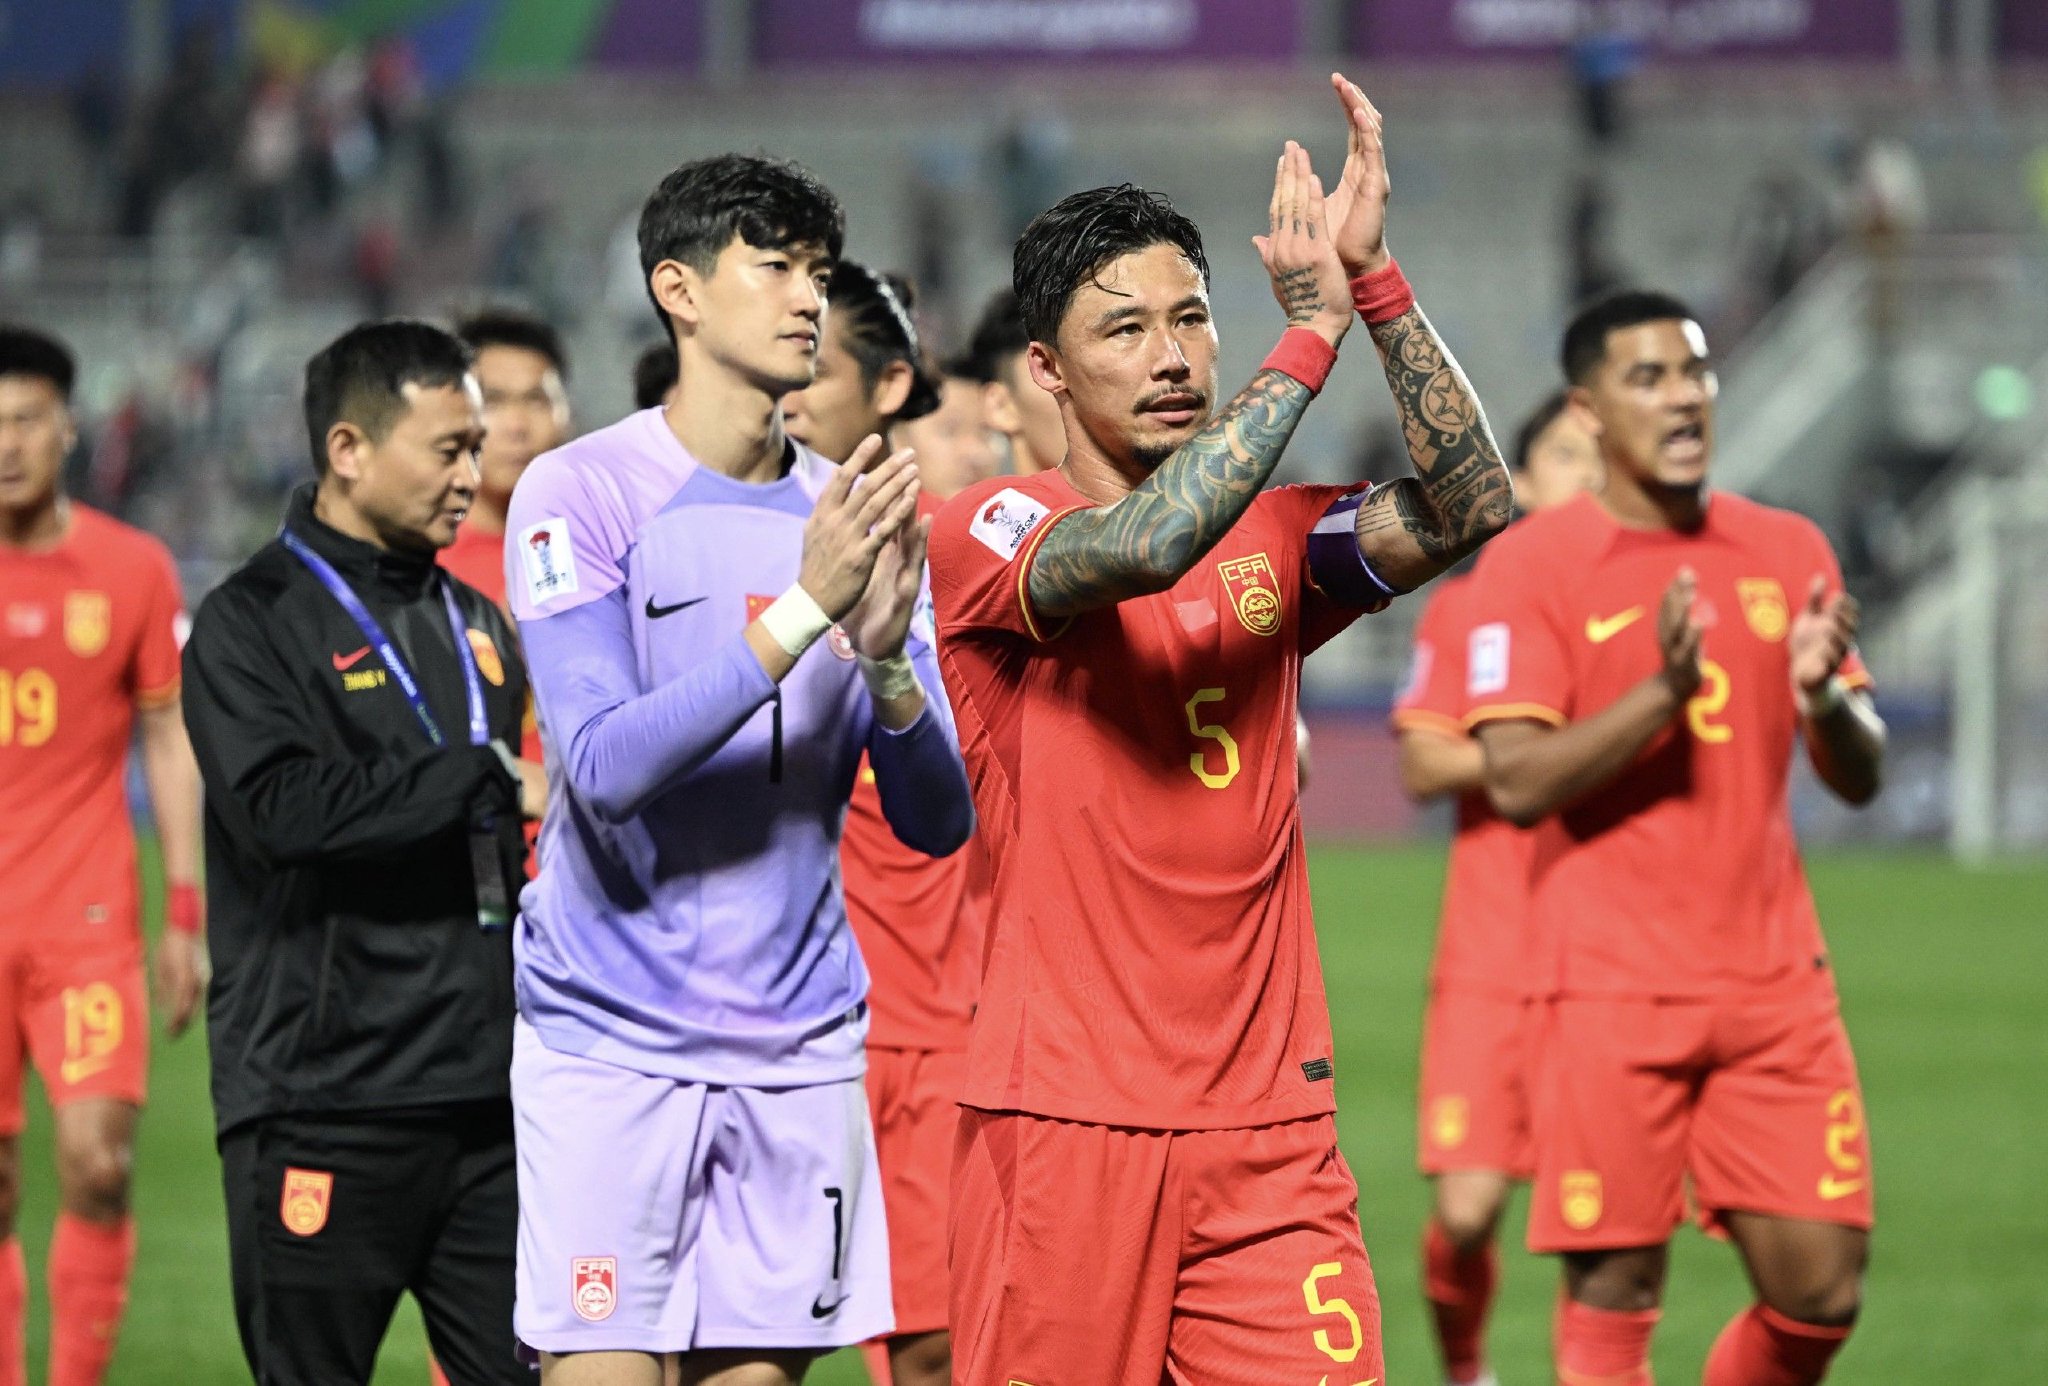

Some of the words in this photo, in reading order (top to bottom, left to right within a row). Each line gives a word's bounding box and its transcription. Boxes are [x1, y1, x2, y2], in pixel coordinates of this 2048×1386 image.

[1009, 526, 1026, 549] ASIAN
[1024, 512, 1036, 527] CUP
[1224, 559, 1267, 581] CFA
[0, 666, 58, 748] 19
[1185, 688, 1241, 789] 5
[1687, 660, 1735, 743] 2
[61, 982, 124, 1058] 19
[1825, 1089, 1862, 1170] 2
[576, 1262, 612, 1275] CFA
[823, 1187, 842, 1280] 1
[1302, 1261, 1363, 1363] 5
